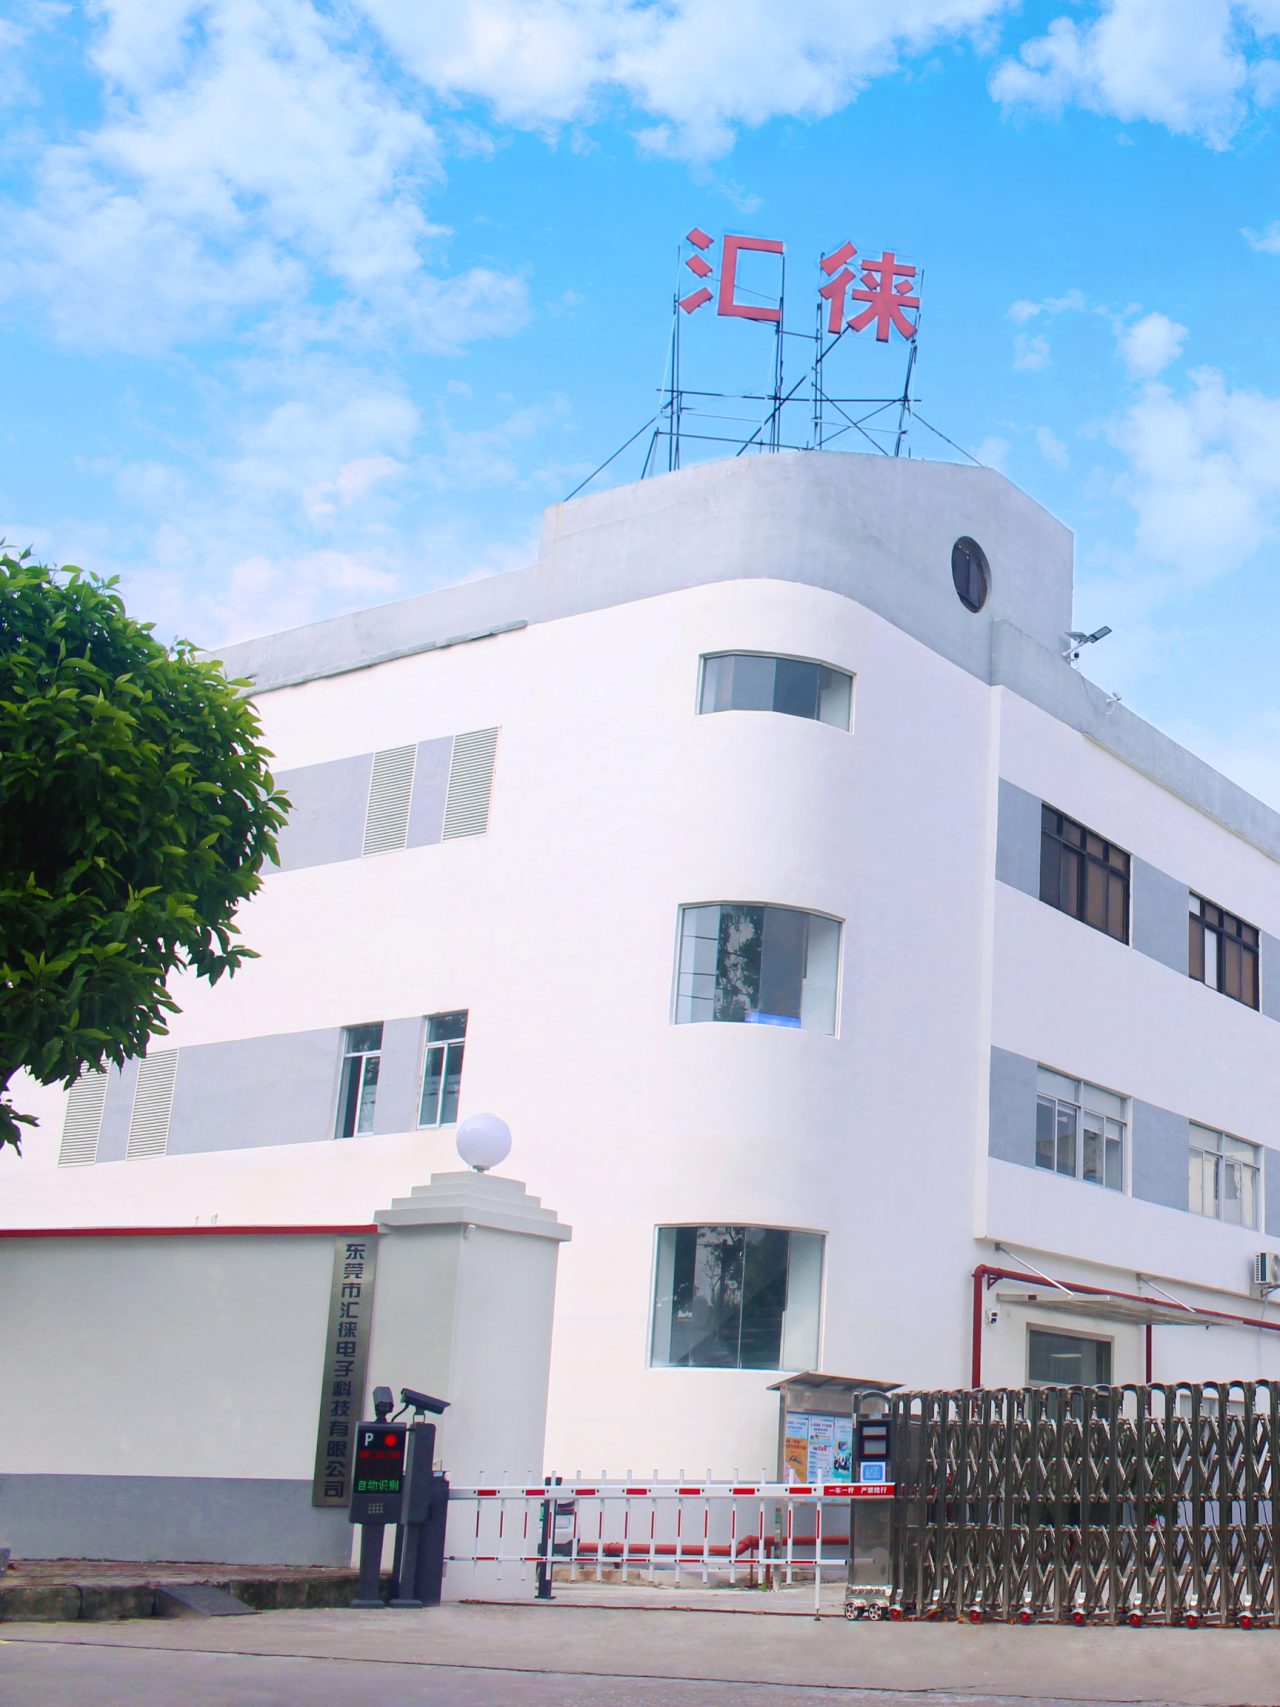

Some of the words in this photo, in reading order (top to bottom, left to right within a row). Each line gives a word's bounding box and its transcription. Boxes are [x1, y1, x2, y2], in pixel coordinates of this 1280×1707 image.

[678, 226, 920, 343] 汇徕
[324, 1243, 366, 1498] 东莞市汇徕电子科技有限公司
[364, 1432, 374, 1447] P
[358, 1480, 399, 1491] 自动识别
